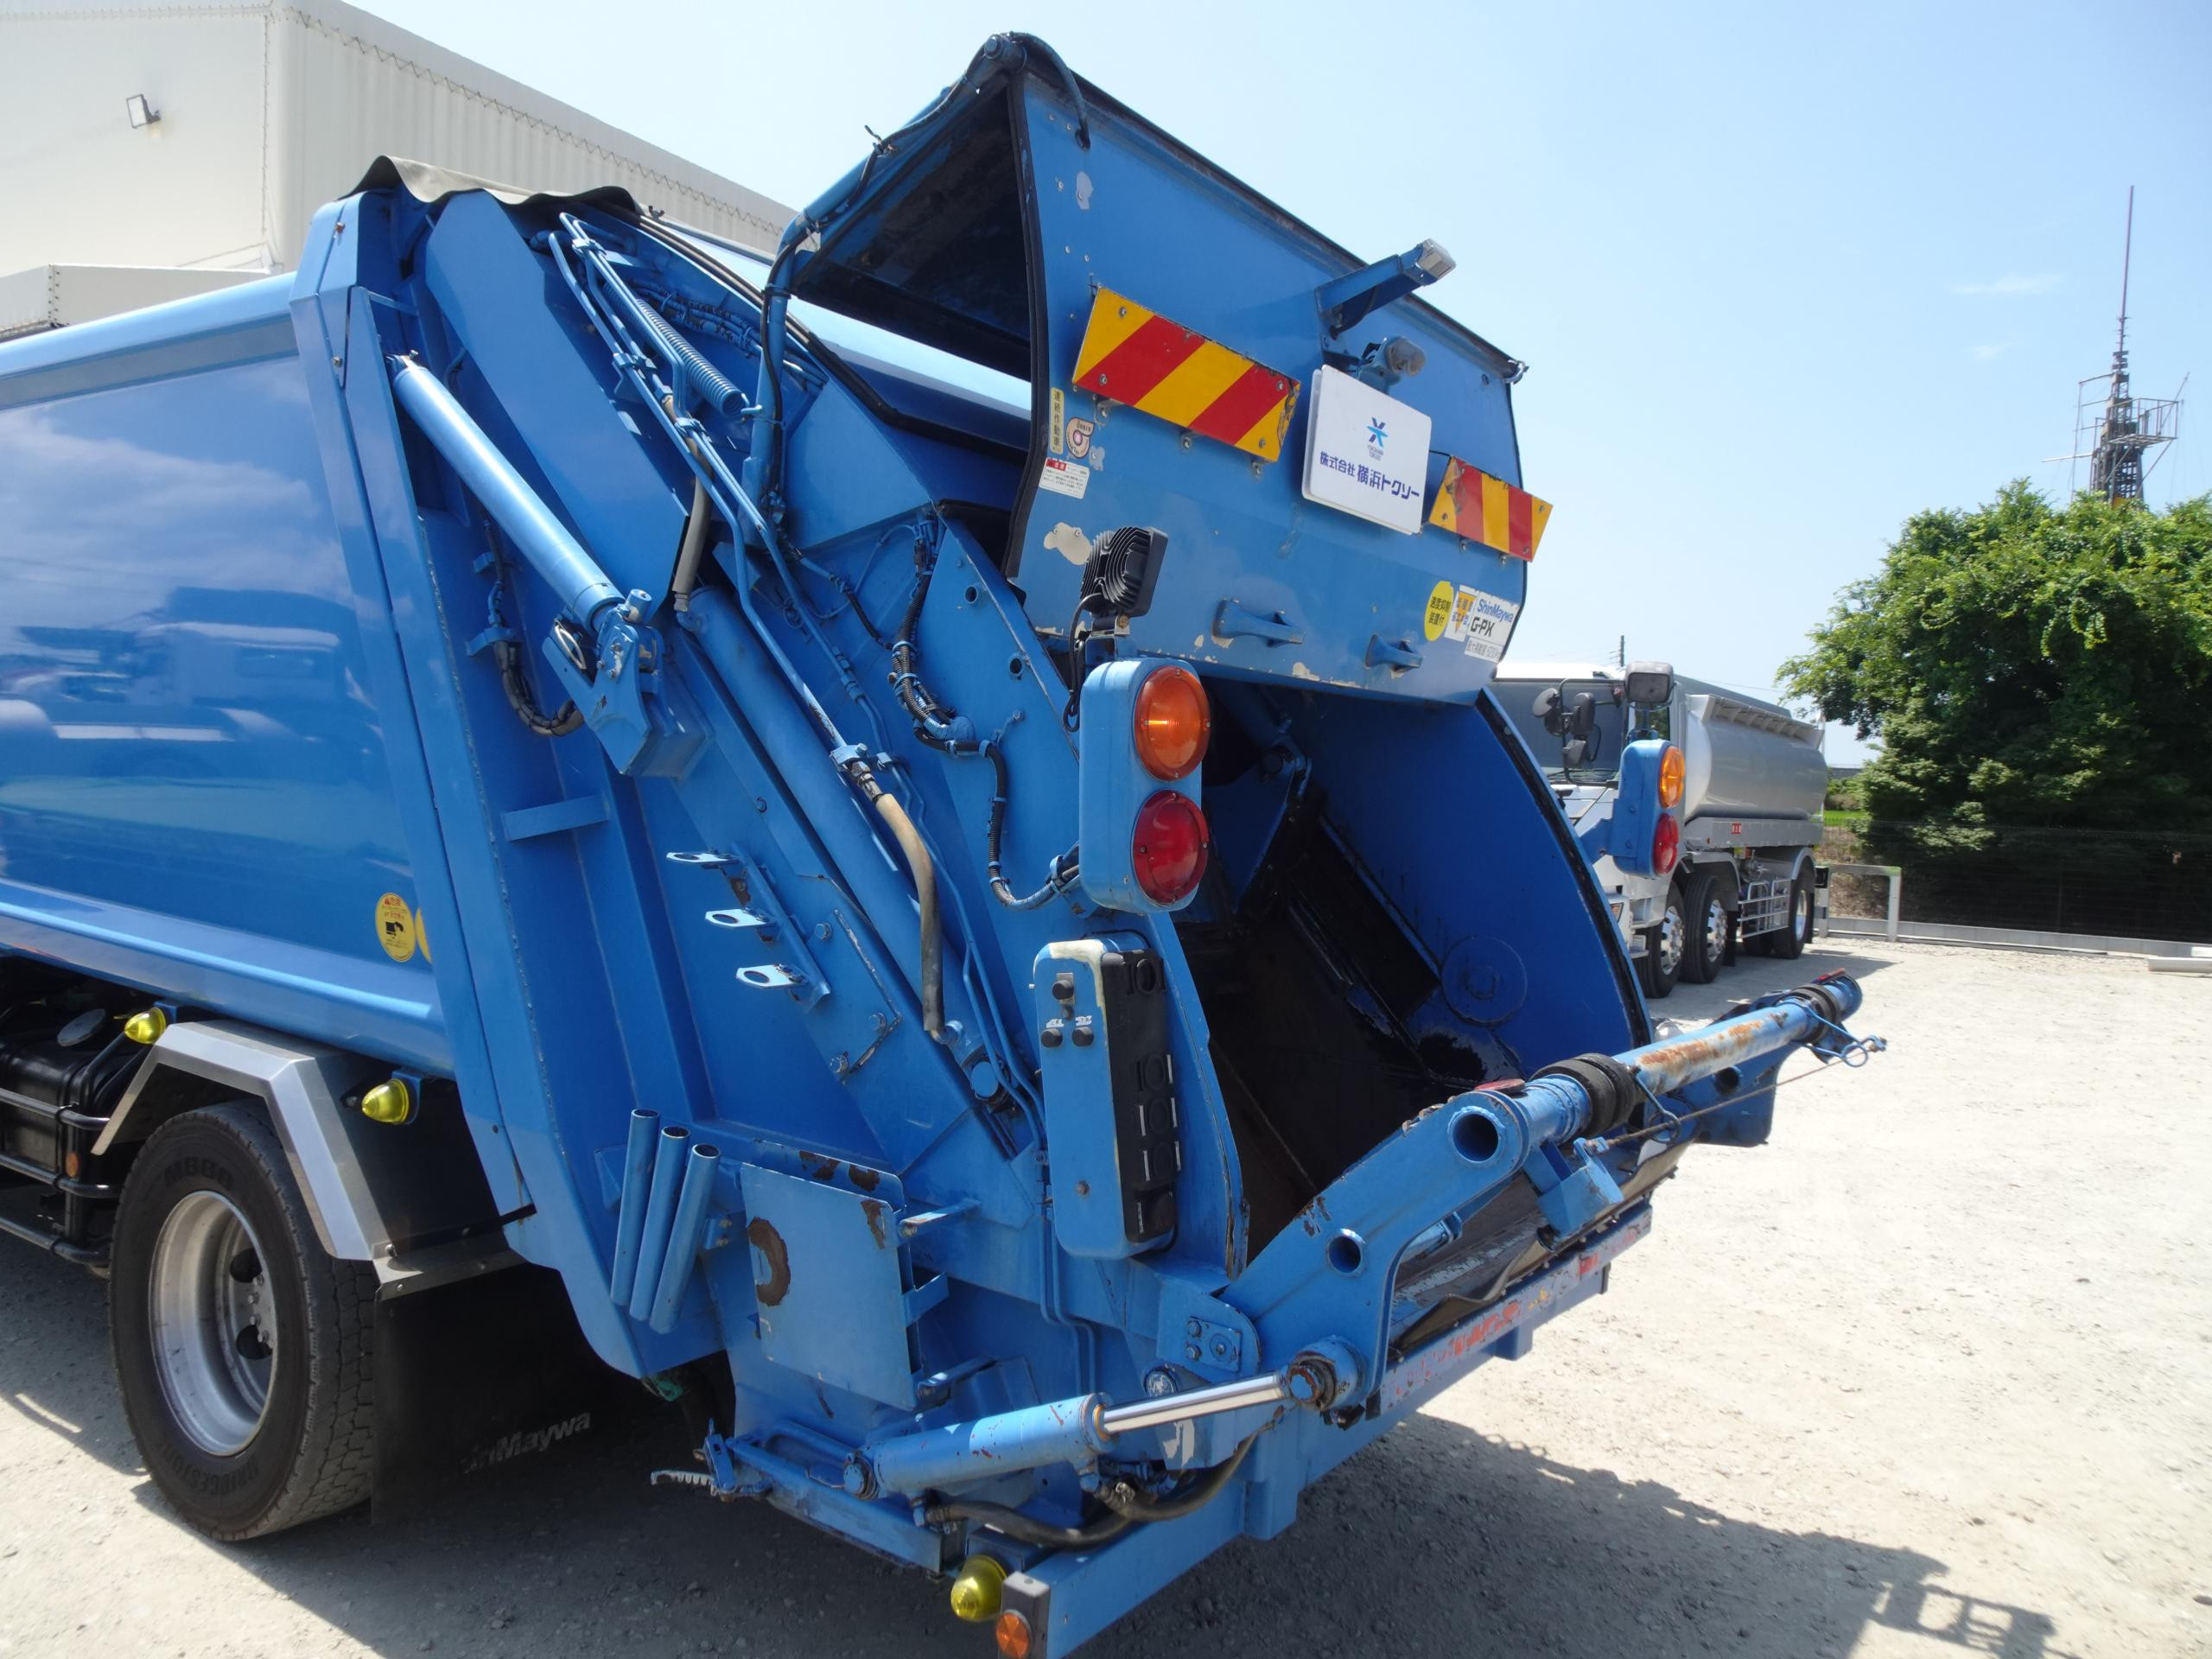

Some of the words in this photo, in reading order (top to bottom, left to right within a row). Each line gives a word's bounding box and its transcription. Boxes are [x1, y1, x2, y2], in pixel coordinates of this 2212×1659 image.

[1319, 450, 1356, 477] 株式会社
[1477, 598, 1515, 623] ShinMaywa
[1470, 616, 1496, 637] G-PX
